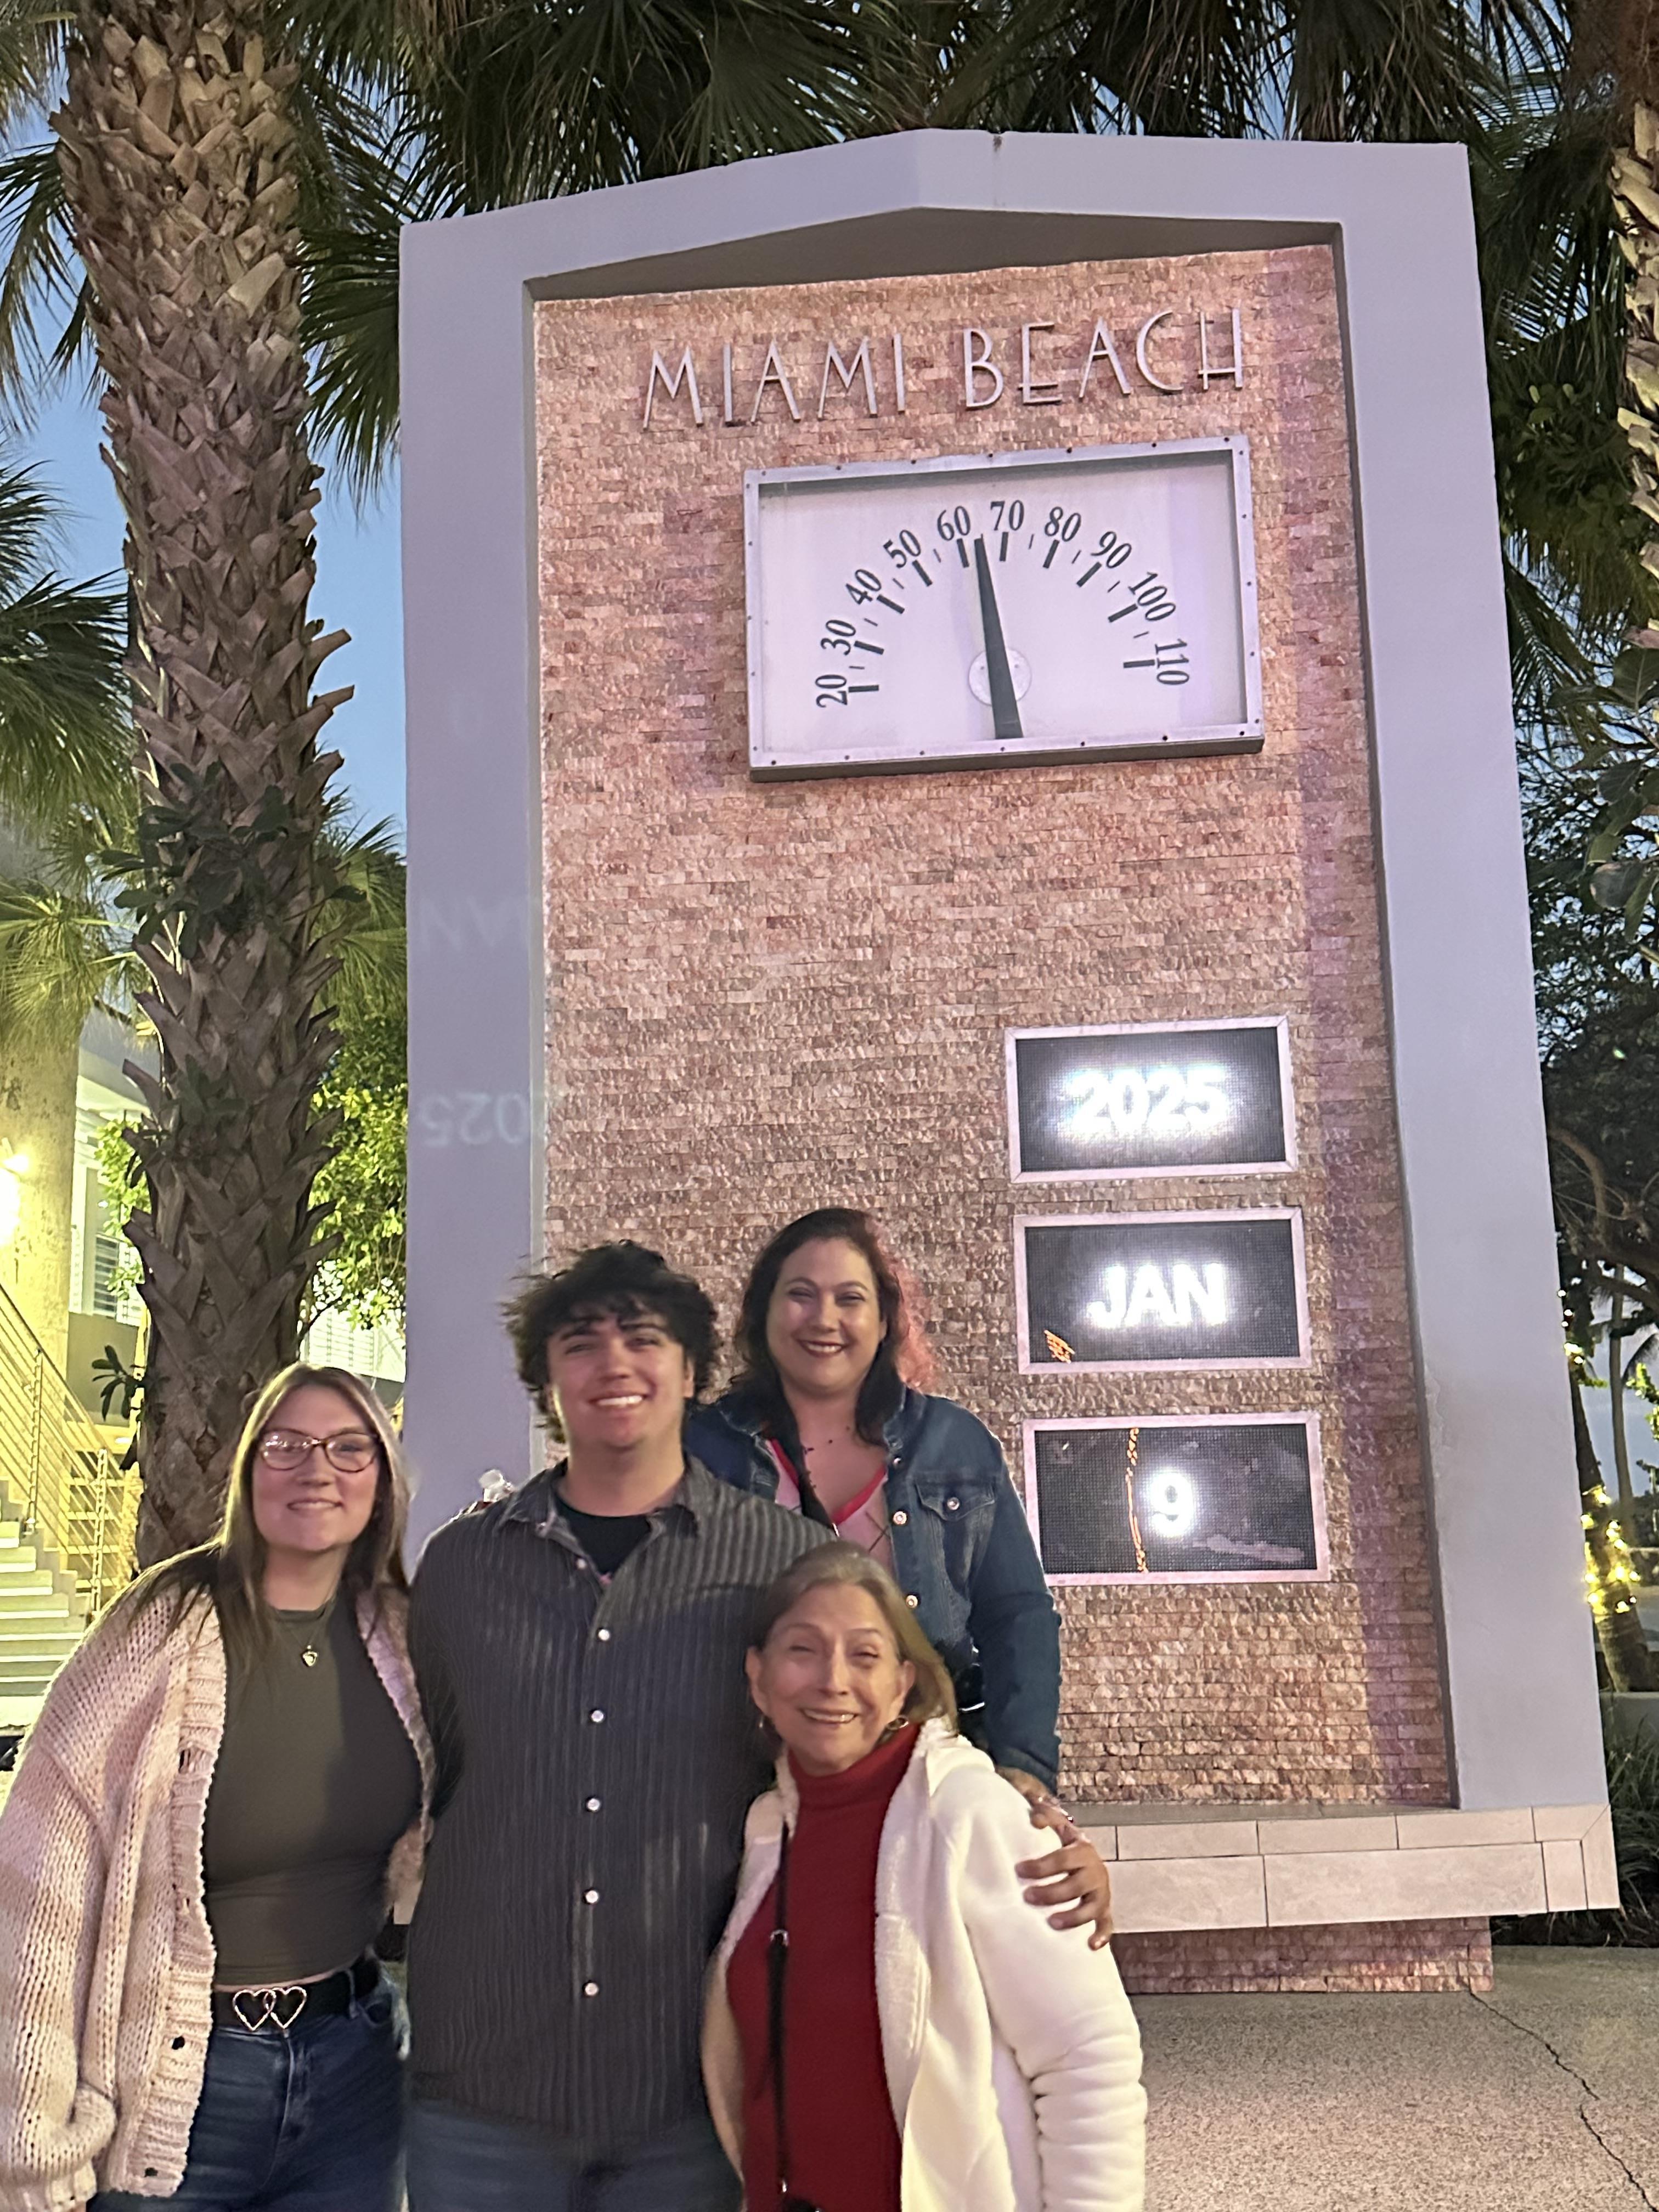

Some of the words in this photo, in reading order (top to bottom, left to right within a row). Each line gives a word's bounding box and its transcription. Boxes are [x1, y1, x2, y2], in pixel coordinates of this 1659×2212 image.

[642, 334, 906, 429] MIAMI
[963, 307, 1243, 411] BEACH
[936, 506, 971, 541] 60
[990, 500, 1024, 532] 70
[1043, 506, 1081, 542] 80
[882, 529, 922, 568] 50
[1091, 531, 1132, 569] 90
[844, 569, 882, 606] 40
[1127, 571, 1176, 622] 100
[821, 620, 856, 655] 30
[1154, 638, 1189, 686] 110
[816, 674, 847, 708] 20
[1064, 1066, 1229, 1136] 2025
[1086, 1262, 1228, 1329] JAN
[1150, 1471, 1195, 1537] 9
